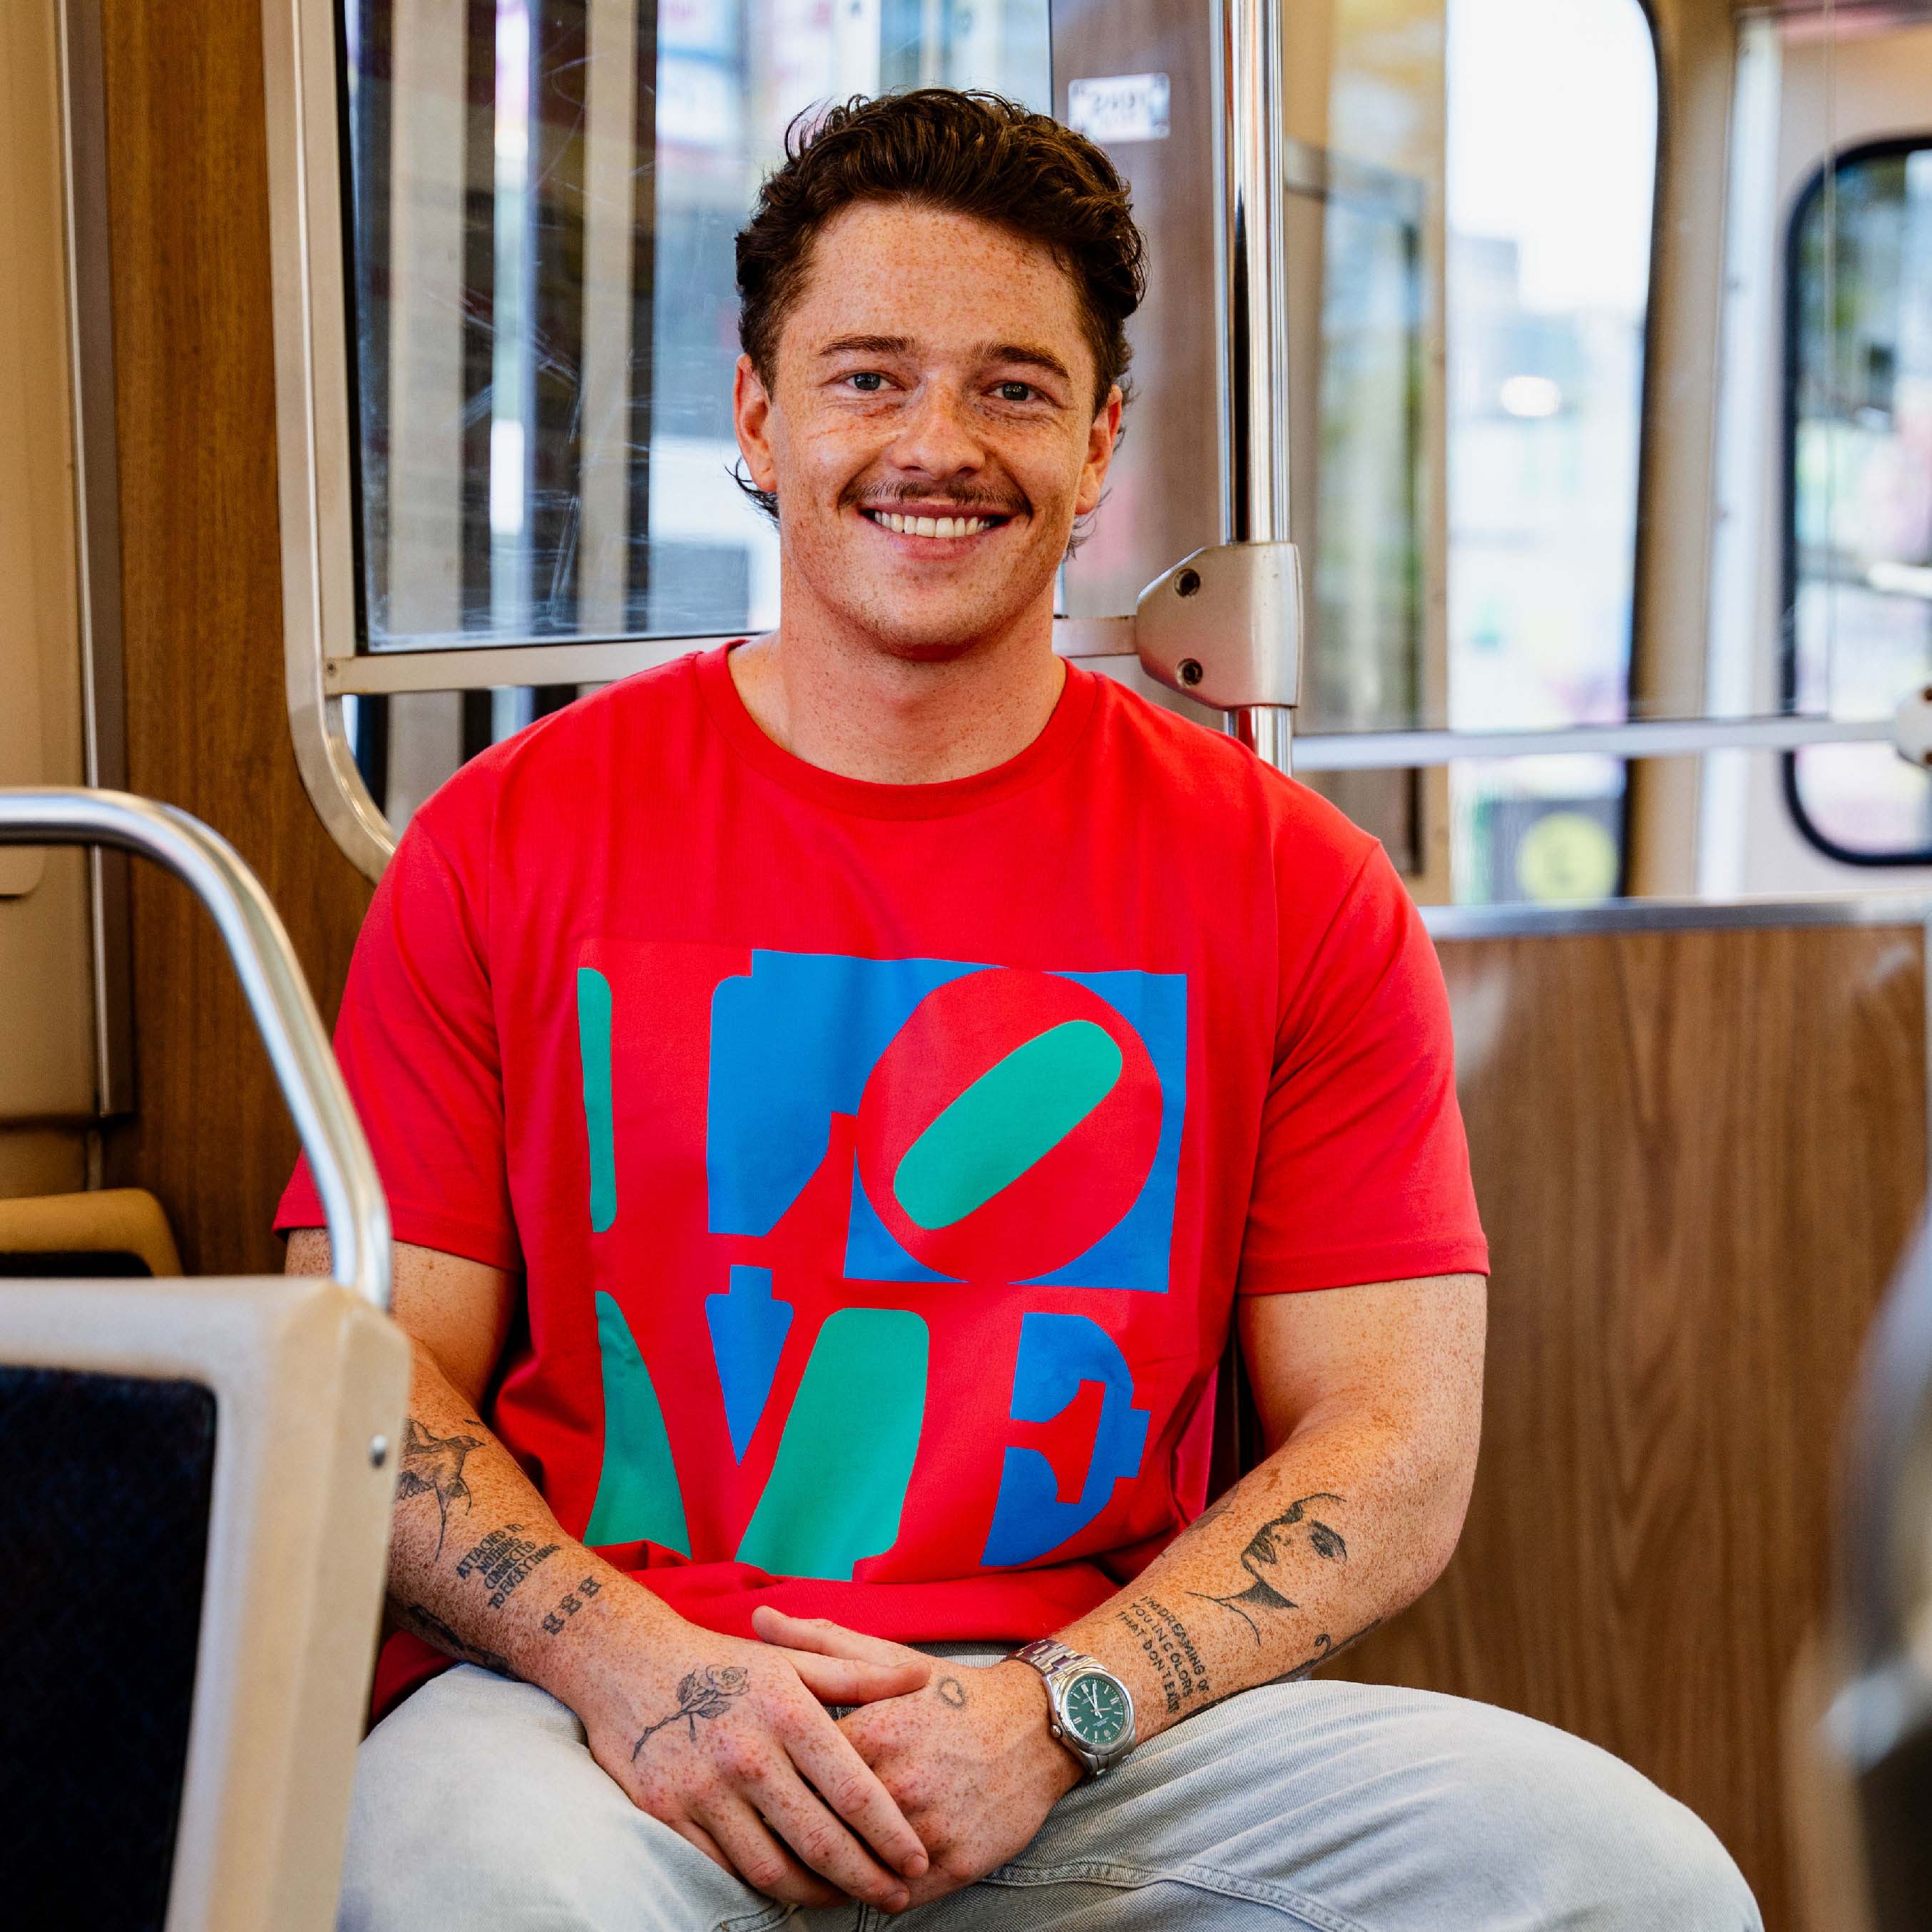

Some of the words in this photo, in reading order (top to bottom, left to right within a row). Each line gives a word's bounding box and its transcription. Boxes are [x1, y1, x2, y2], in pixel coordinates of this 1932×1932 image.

[456, 1530, 506, 1580] ATTACHED
[505, 1523, 525, 1533] TO
[476, 1535, 521, 1575] NOTHING
[484, 1540, 536, 1590] CONNECTED
[488, 1592, 505, 1609] TO
[500, 1543, 561, 1596] EVERYTHING
[1116, 1611, 1146, 1637] THAT
[1143, 1639, 1171, 1679] DON'T
[1130, 1603, 1152, 1623] YOU
[1152, 1622, 1168, 1642] IN
[1163, 1642, 1193, 1697] COLORS
[1158, 1608, 1205, 1676] DREAMING
[1197, 1679, 1210, 1692] OF
